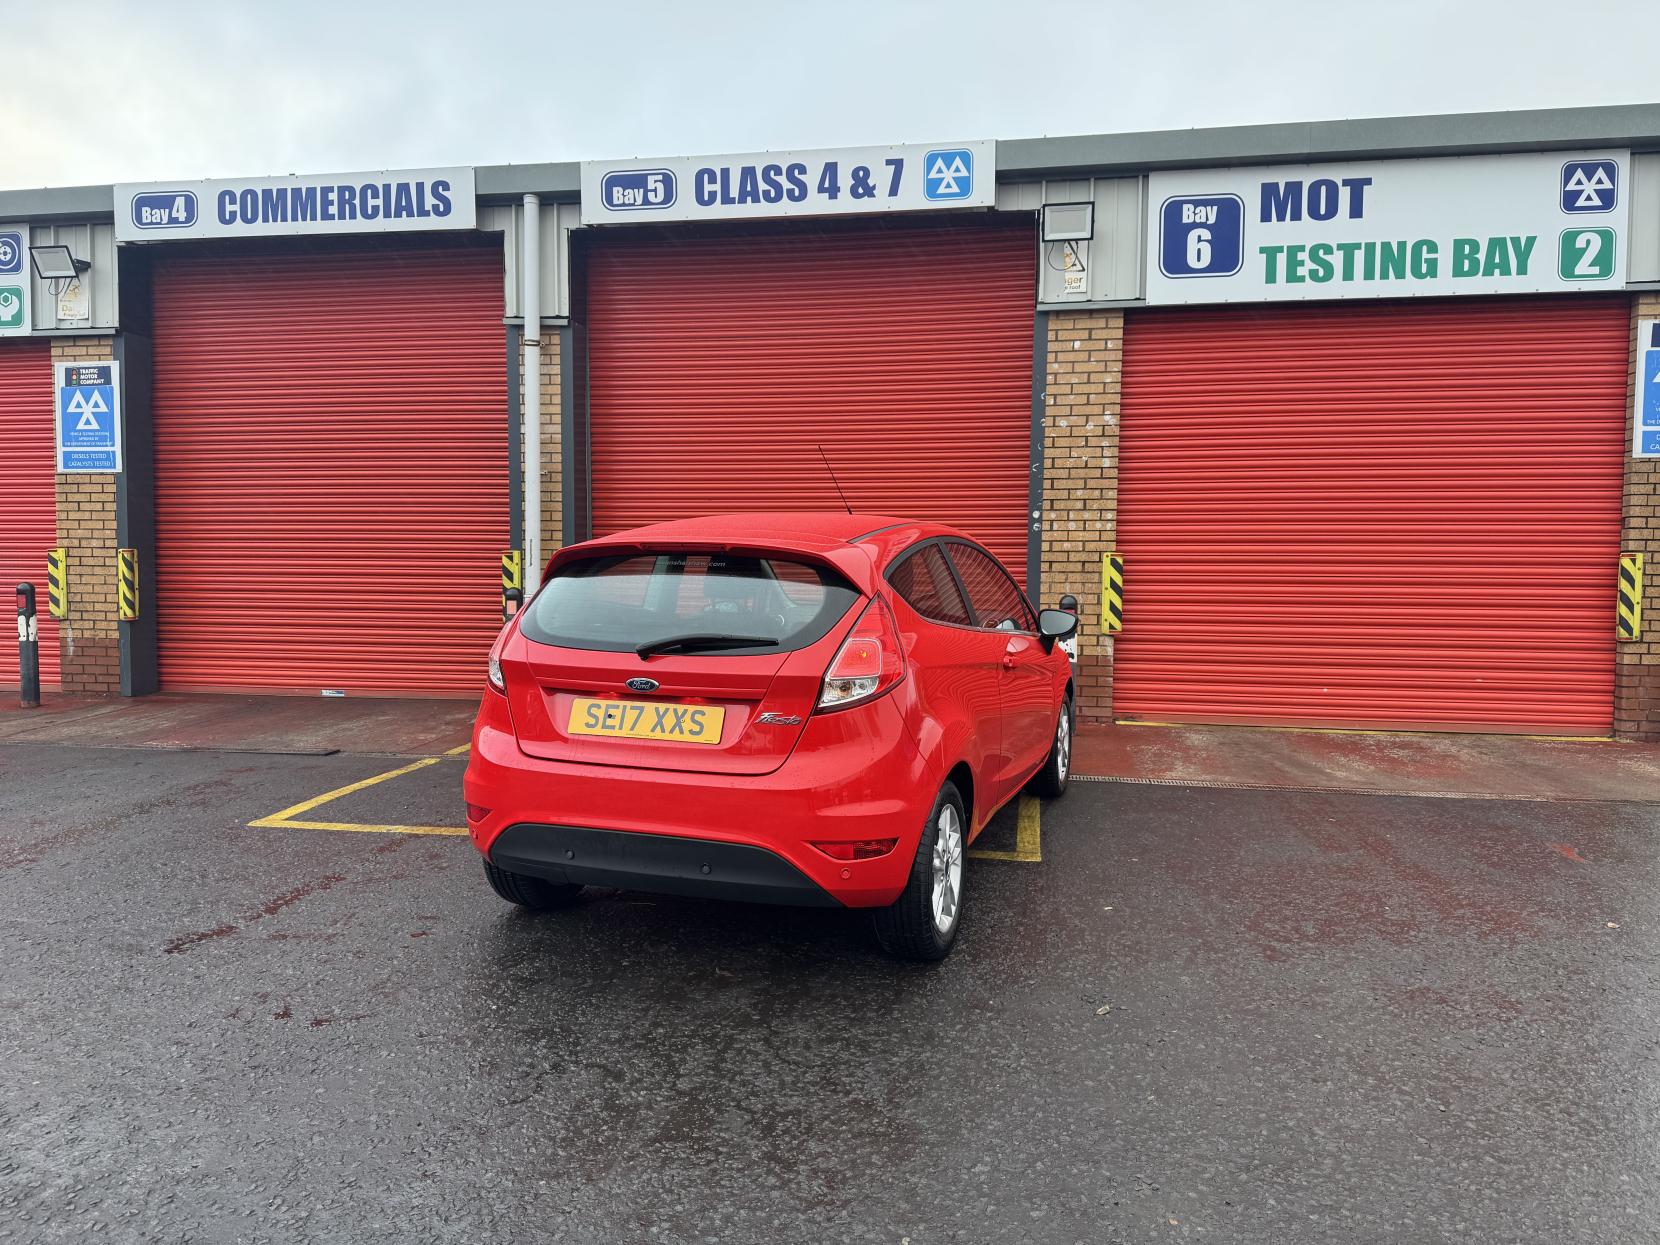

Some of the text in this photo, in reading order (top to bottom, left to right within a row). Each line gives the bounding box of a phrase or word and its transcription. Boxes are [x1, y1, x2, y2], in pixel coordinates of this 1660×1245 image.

[612, 174, 664, 206] Bay 5
[695, 158, 904, 206] CLASS 4 & 7
[1260, 177, 1373, 223] MOT
[141, 196, 187, 225] Bay 4
[217, 180, 452, 226] COMMERCIALS
[1182, 203, 1218, 224] Bay
[1186, 228, 1212, 269] 6
[1258, 235, 1538, 285] TESTING BAY
[1574, 231, 1602, 275] 2
[632, 680, 651, 690] Ford
[584, 703, 706, 736] SE17 XXS
[754, 711, 801, 725] Fiesta
